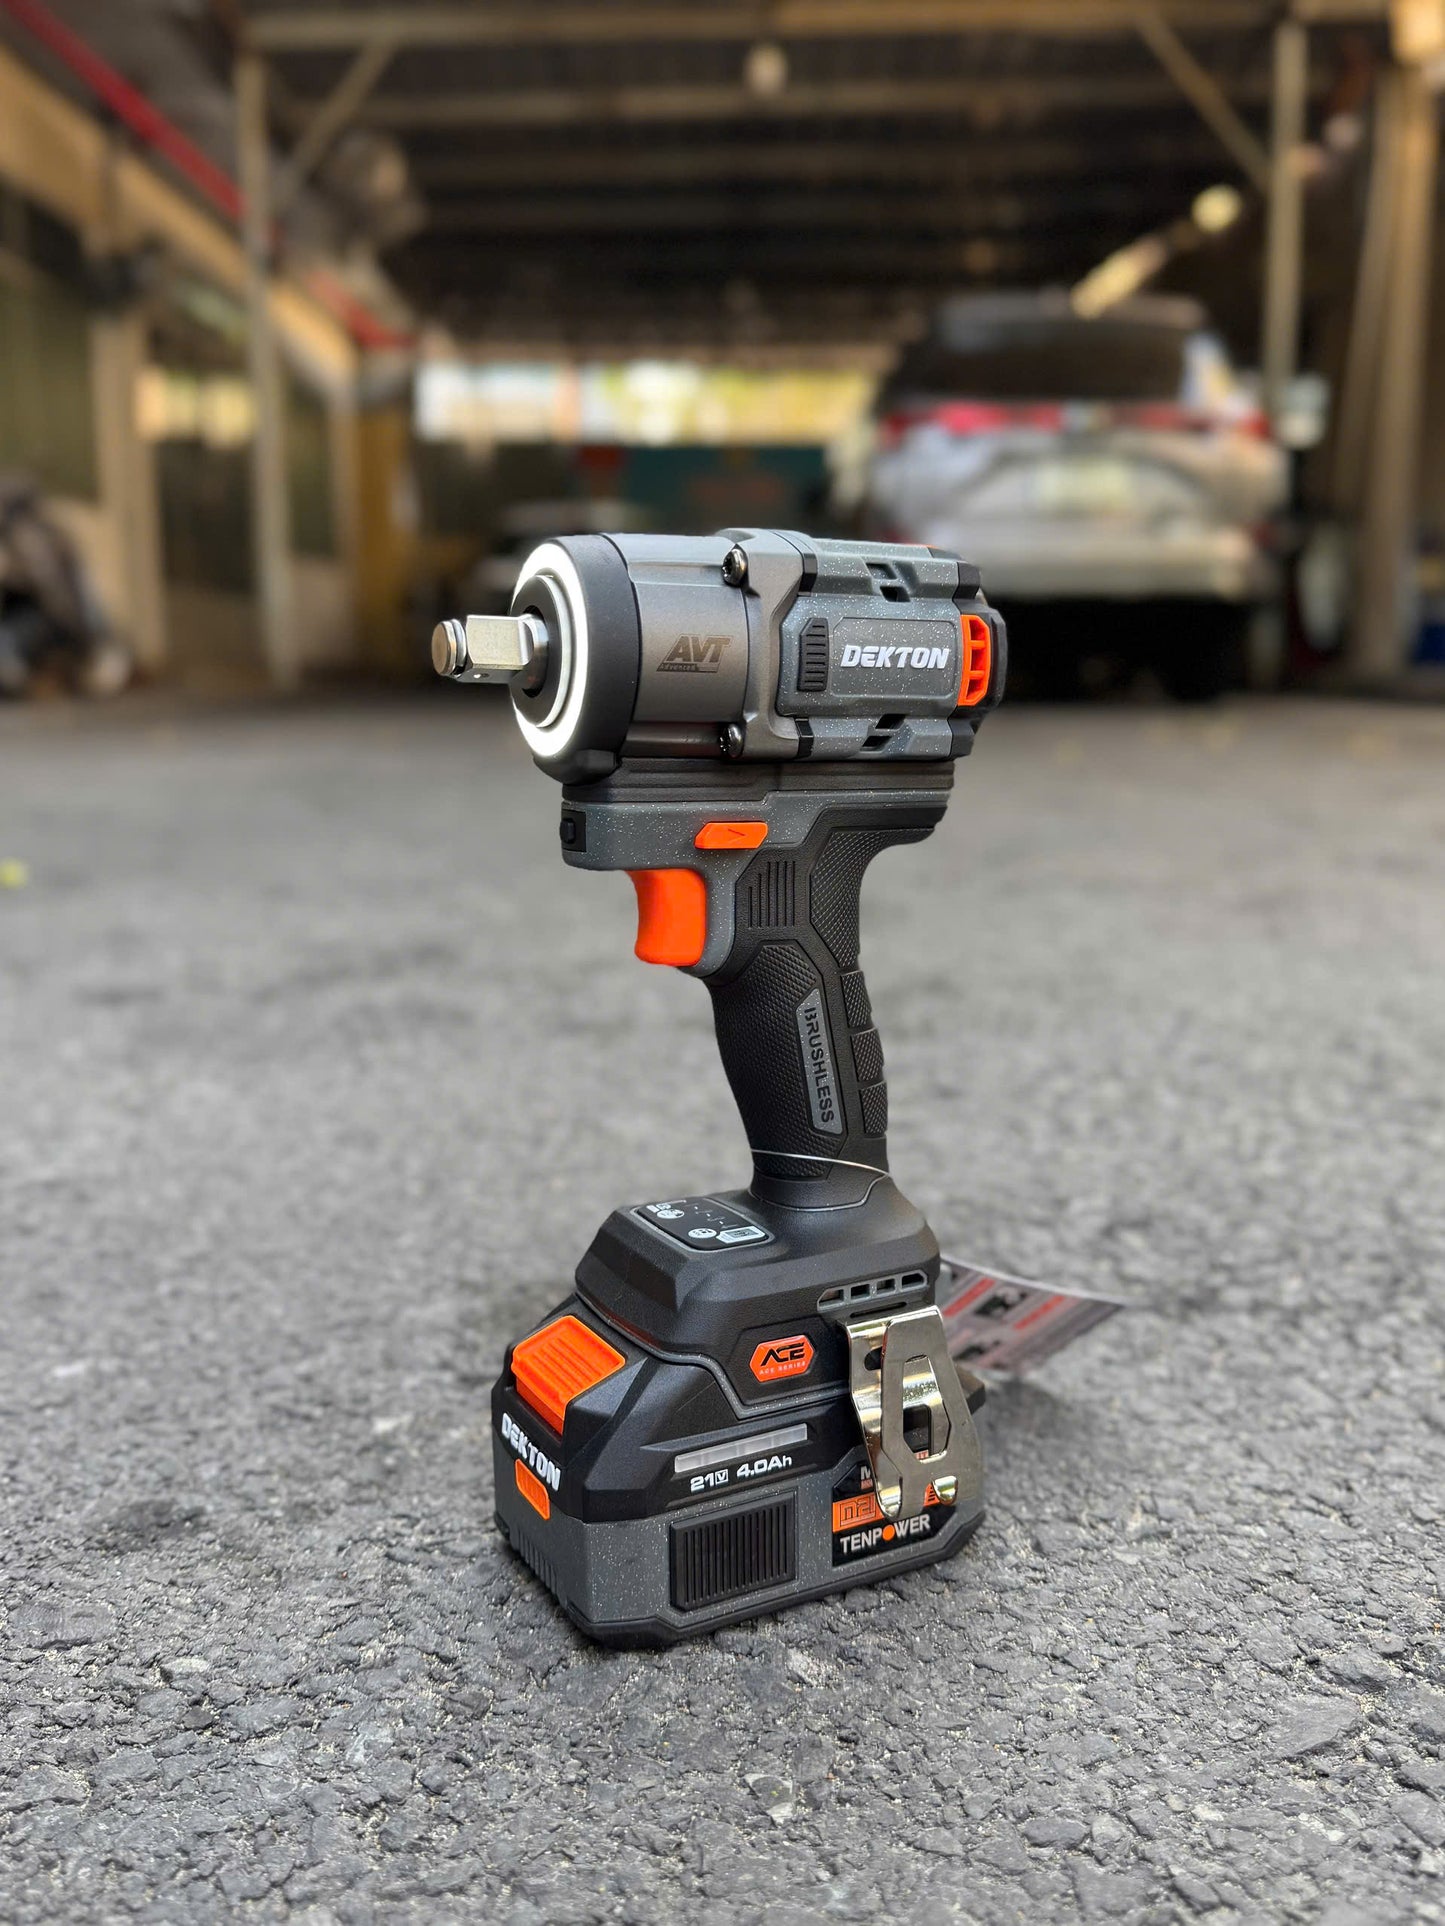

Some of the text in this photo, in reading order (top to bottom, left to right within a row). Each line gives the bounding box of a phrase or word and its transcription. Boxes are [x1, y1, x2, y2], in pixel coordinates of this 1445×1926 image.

[666, 635, 731, 662] AVT
[840, 644, 950, 669] DEKTON
[804, 1007, 835, 1123] BRUSHLESS
[760, 1342, 805, 1366] ACE
[778, 1361, 806, 1371] SERIES
[501, 1412, 562, 1492] DEKTON
[736, 1455, 793, 1478] 4.0Ah
